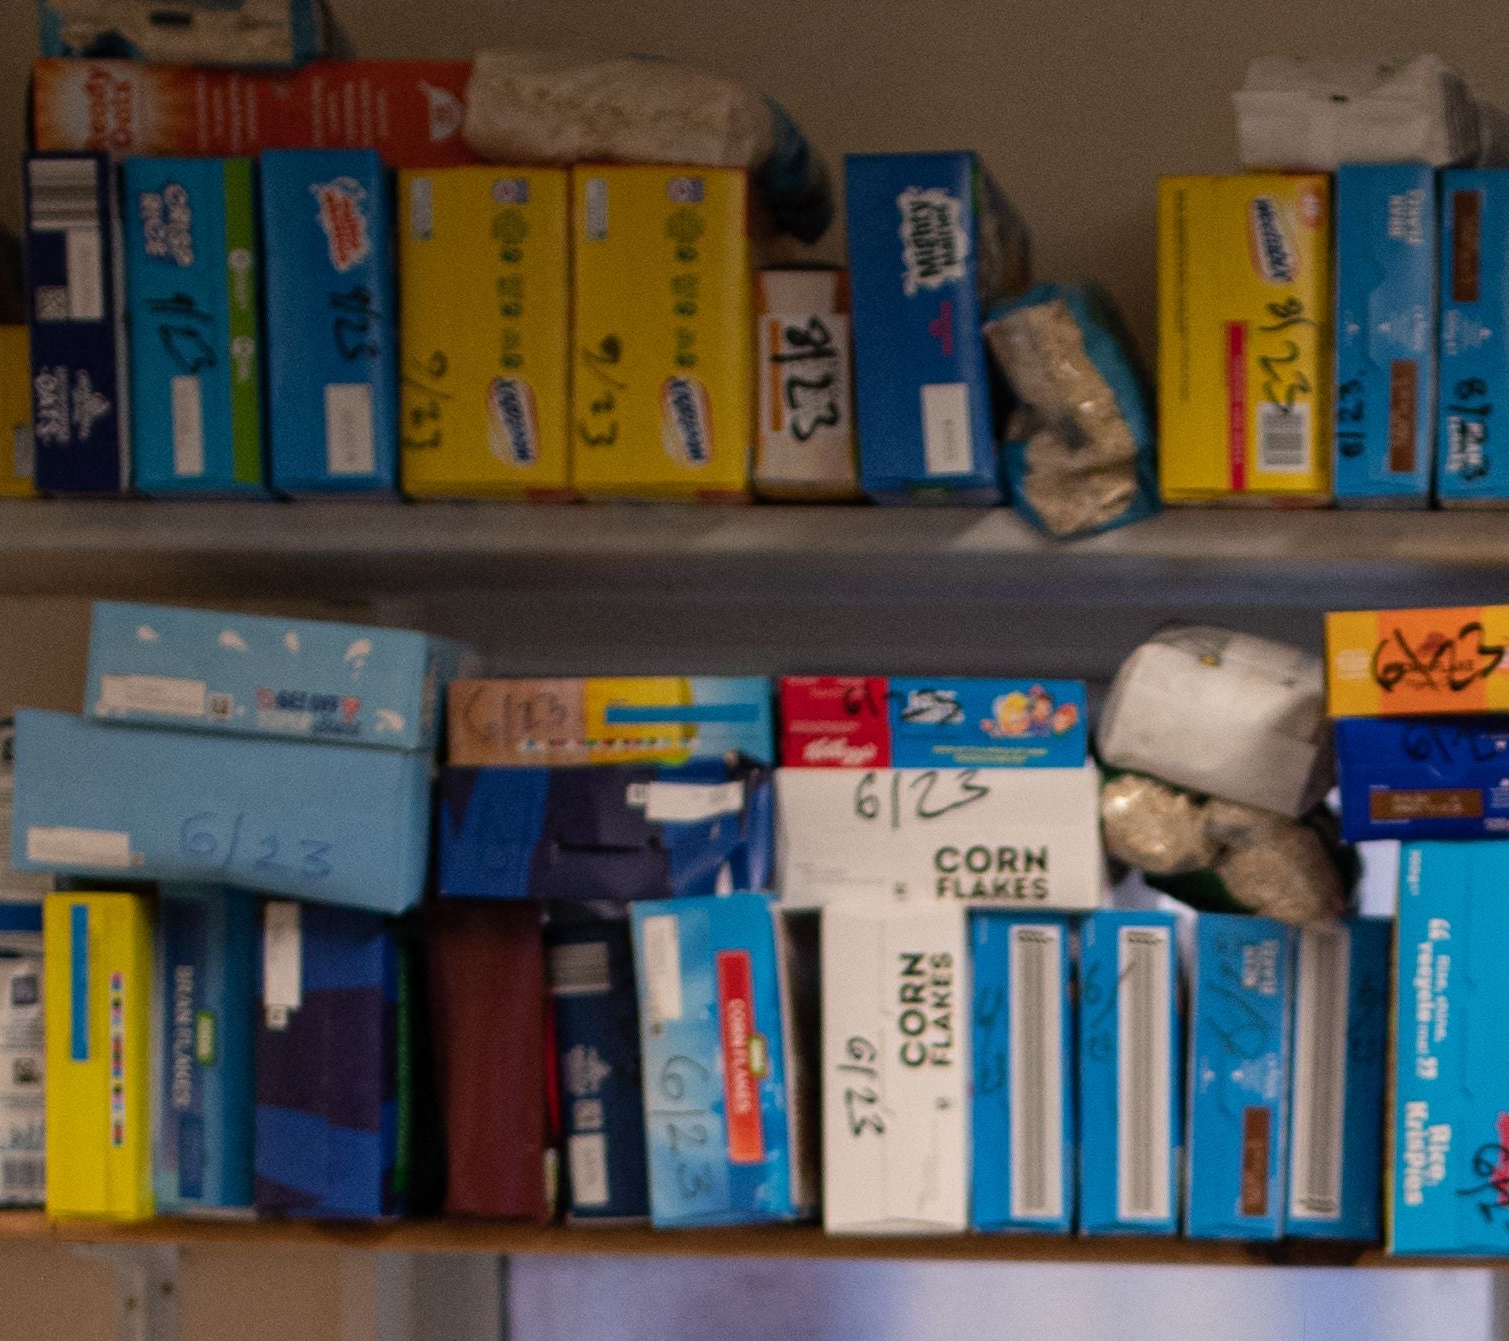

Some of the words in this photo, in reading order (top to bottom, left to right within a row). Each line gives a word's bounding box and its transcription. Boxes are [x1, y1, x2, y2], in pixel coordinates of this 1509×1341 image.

[180, 809, 333, 880] 6/23
[854, 770, 991, 830] 6/23
[933, 845, 1049, 875] CORN
[933, 877, 1050, 901] FLAKES
[897, 951, 927, 1069] CORN
[930, 951, 953, 1068] FLAKES
[639, 1054, 716, 1200] 6/23
[837, 1034, 885, 1139] 6/23
[1402, 1101, 1430, 1206] Krispies
